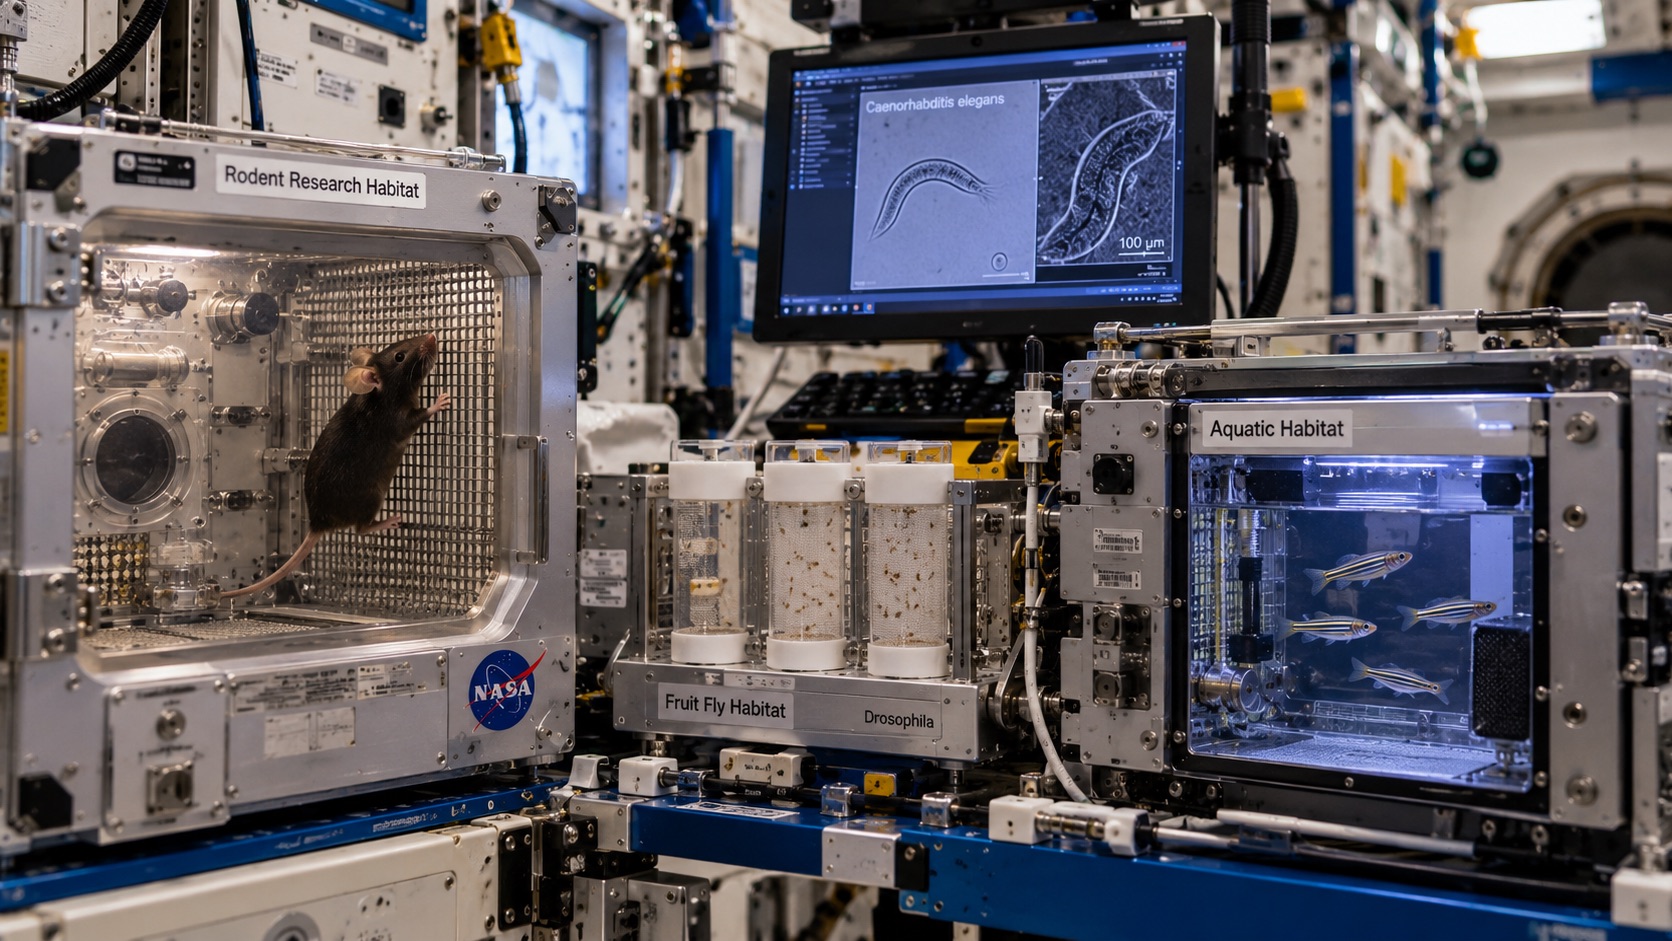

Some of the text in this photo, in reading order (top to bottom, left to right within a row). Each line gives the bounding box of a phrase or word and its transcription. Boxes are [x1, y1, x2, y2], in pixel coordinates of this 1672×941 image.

[866, 94, 1005, 113] Caenorhabditis elegans
[225, 165, 420, 199] Rodent Research Habitat
[1119, 236, 1142, 249] 100
[1210, 419, 1344, 441] Aquatic Habitat
[474, 679, 532, 702] NASA
[665, 693, 786, 719] Fruit Fly Habitat
[864, 709, 934, 730] Drosophila
